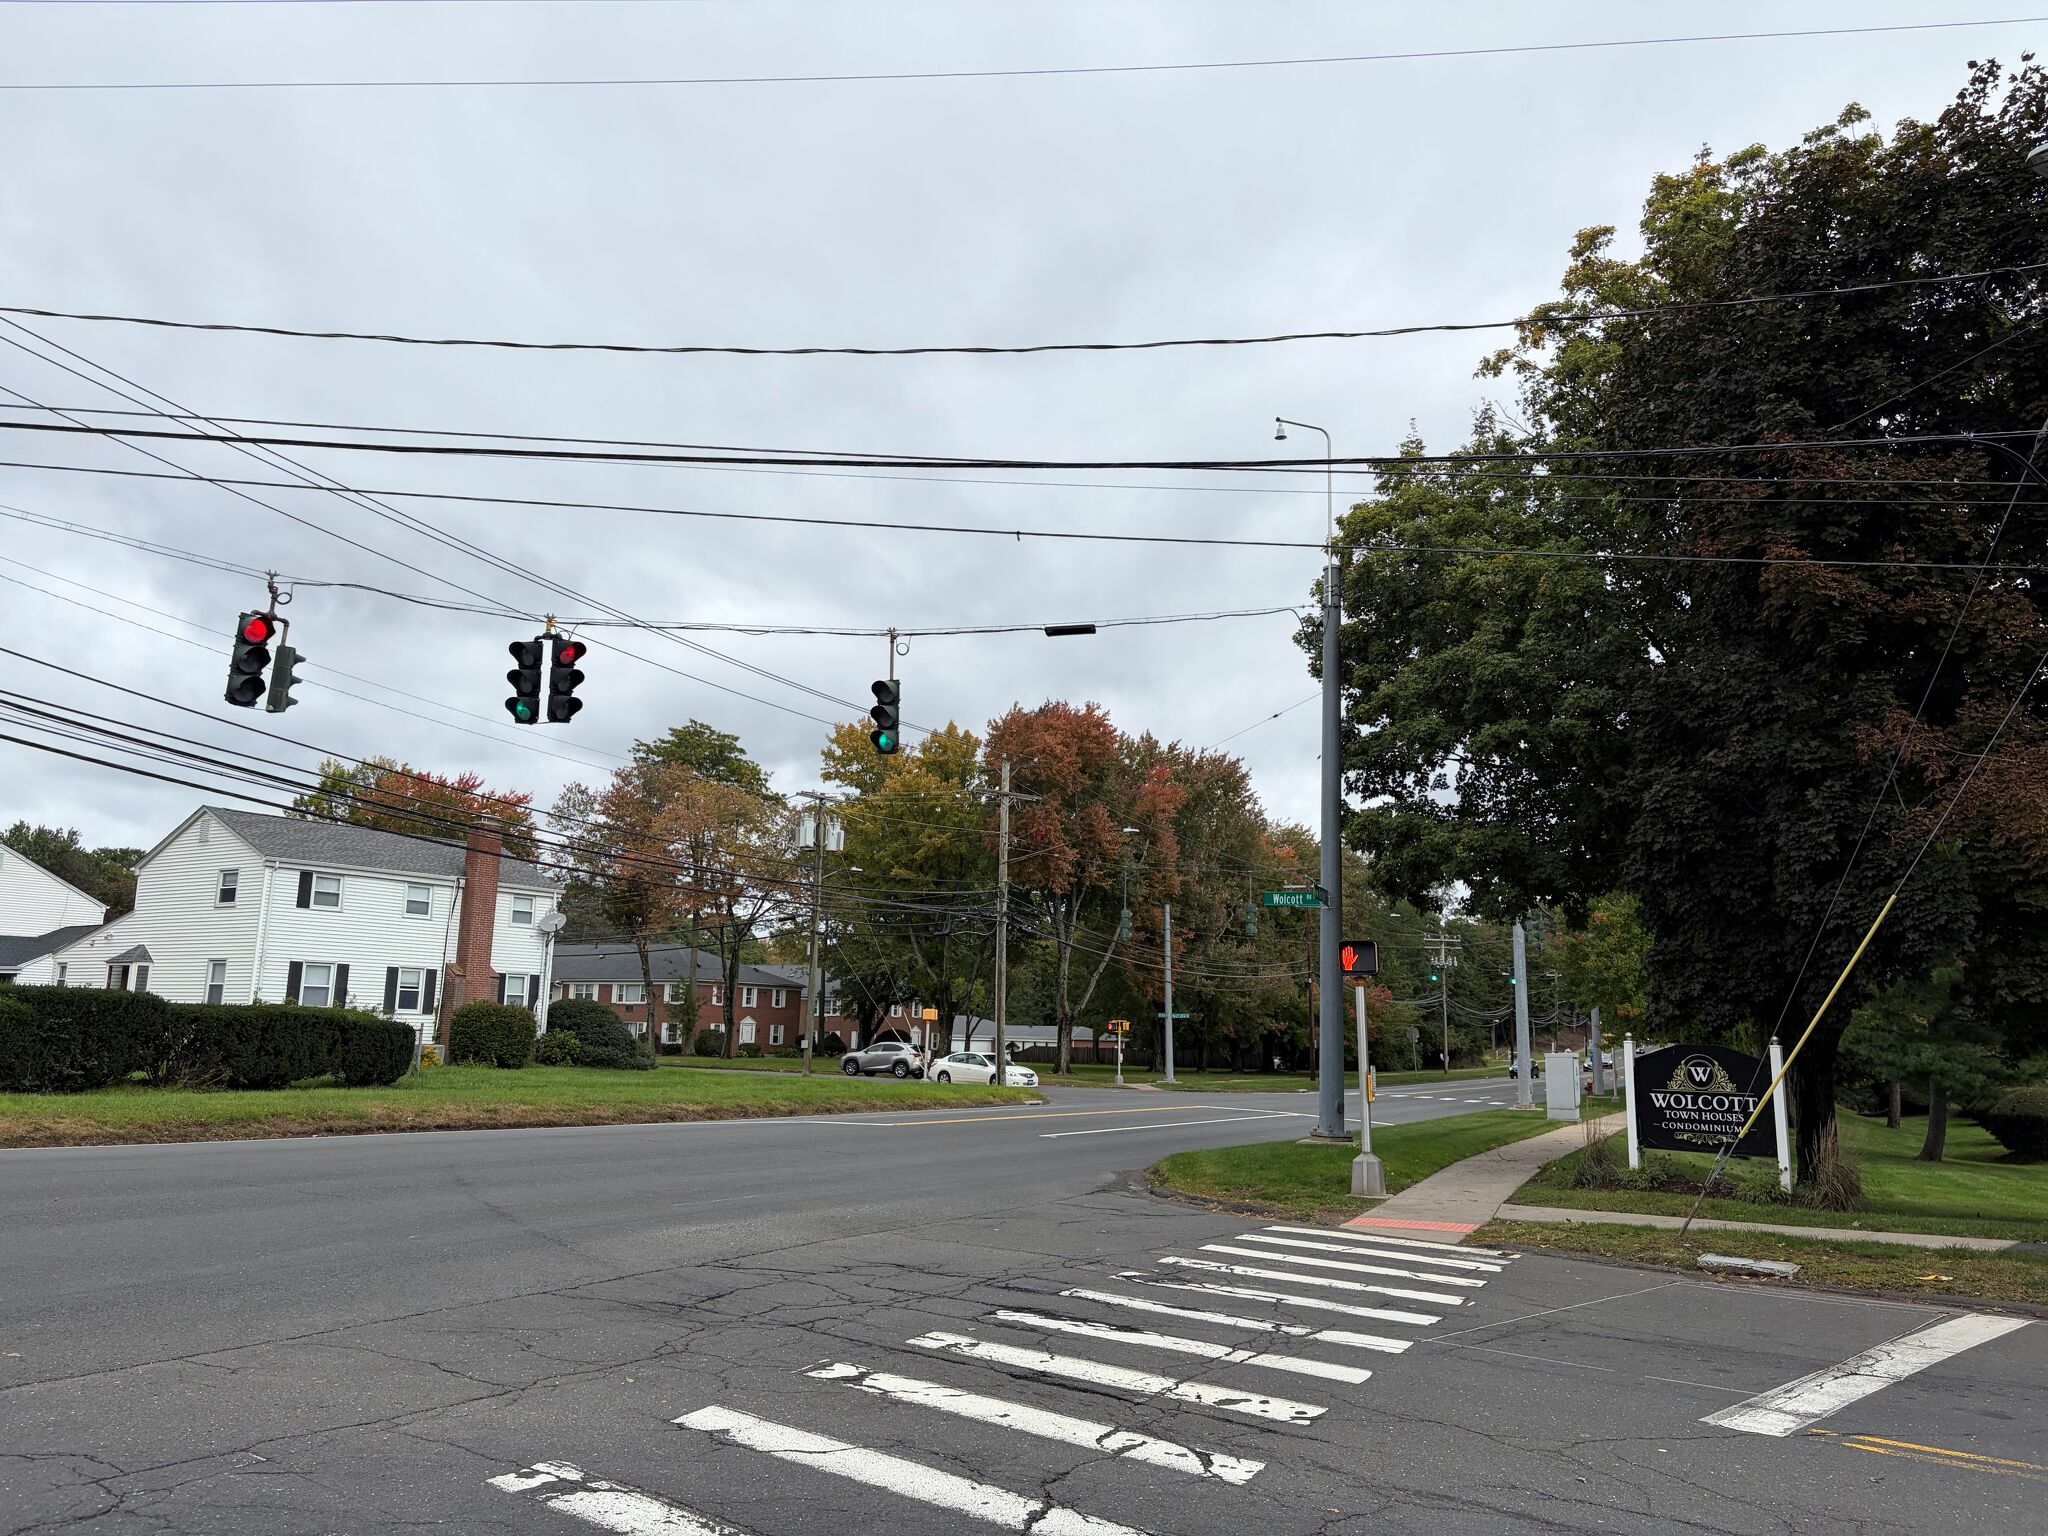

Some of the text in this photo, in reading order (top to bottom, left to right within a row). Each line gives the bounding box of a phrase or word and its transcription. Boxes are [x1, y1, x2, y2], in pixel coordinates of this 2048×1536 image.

[1272, 894, 1302, 904] Wolcott
[1688, 1066, 1712, 1082] W
[1649, 1093, 1758, 1112] WOLCOTT
[1664, 1110, 1745, 1122] TOWN HOUSES
